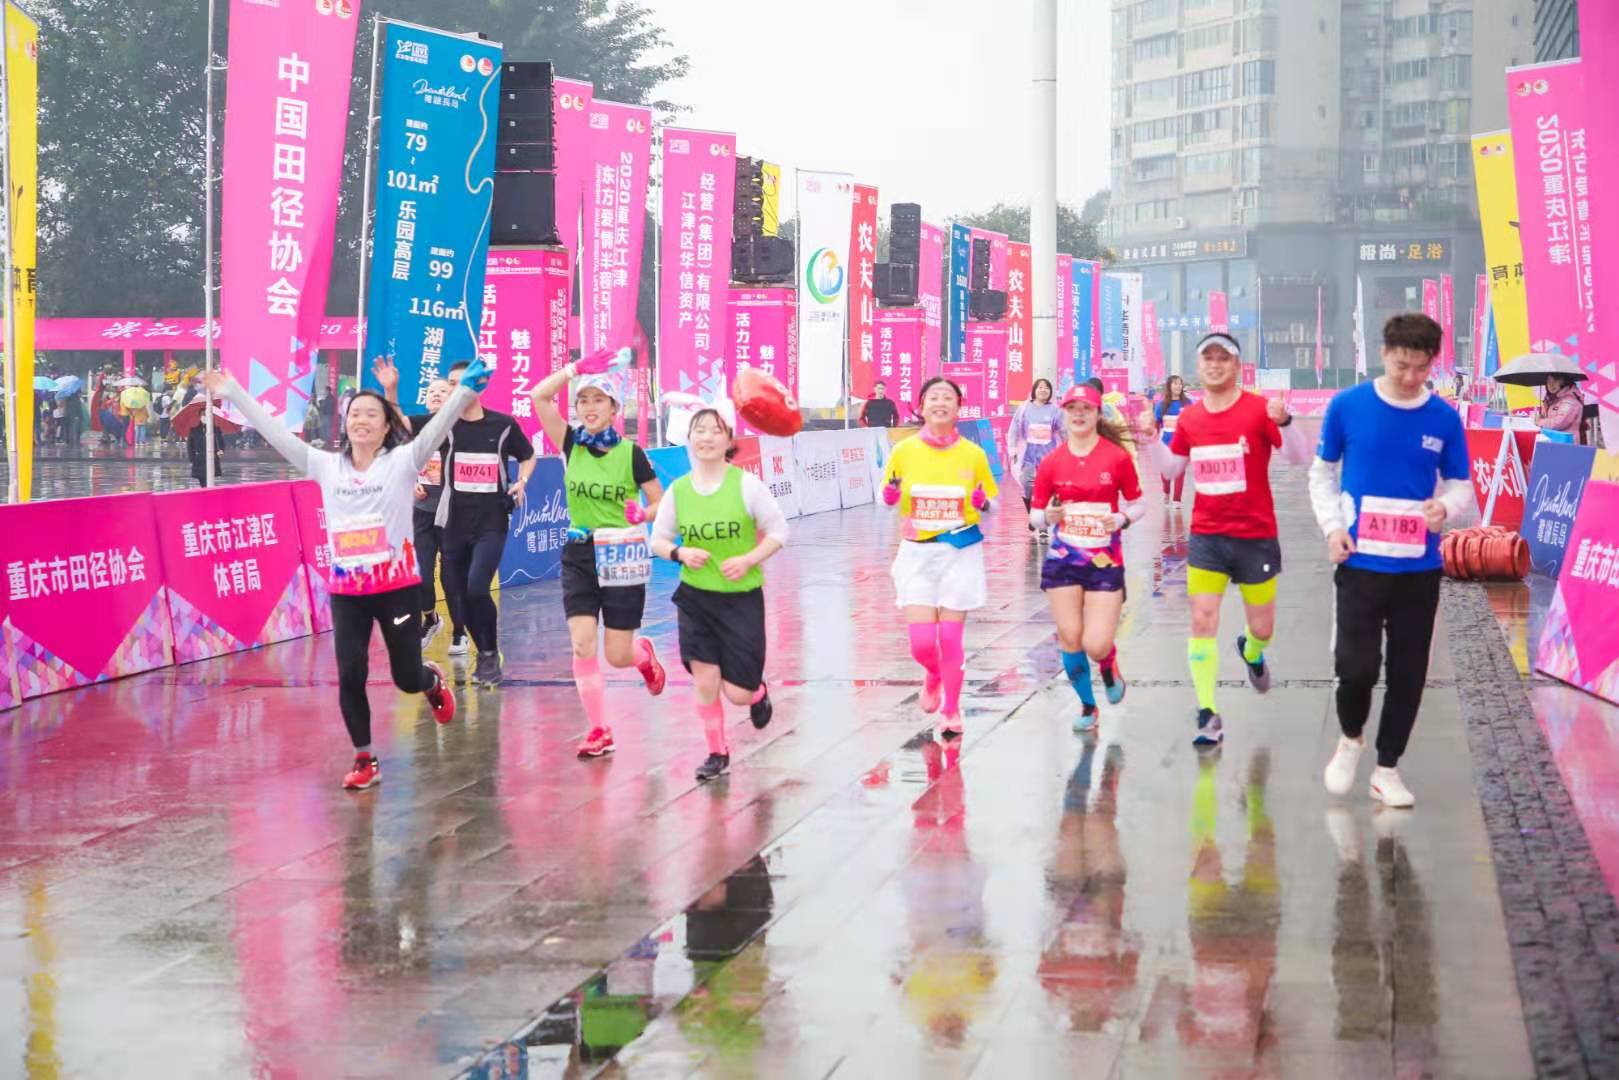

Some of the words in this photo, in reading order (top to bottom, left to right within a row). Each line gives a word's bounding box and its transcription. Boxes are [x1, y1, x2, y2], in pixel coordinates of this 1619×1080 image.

[405, 132, 428, 152] 79
[266, 52, 310, 317] 中国田径协会
[391, 200, 416, 280] 乐园高层
[678, 191, 697, 329] 江津区华信资产
[429, 260, 454, 279] 99
[858, 221, 874, 363] 农夫山泉
[1008, 268, 1024, 373] 农夫山泉
[511, 329, 531, 417] 魅力之城
[880, 327, 893, 377] 活力江津
[900, 352, 912, 402] 魅力之城
[569, 480, 628, 501] PACER
[181, 513, 278, 558] 重庆市江津区
[680, 520, 741, 543] PACER
[1369, 516, 1418, 534] A1183
[7, 546, 146, 601] 重庆市田径协会
[213, 558, 261, 598] 体育局
[607, 543, 647, 563] 3:00
